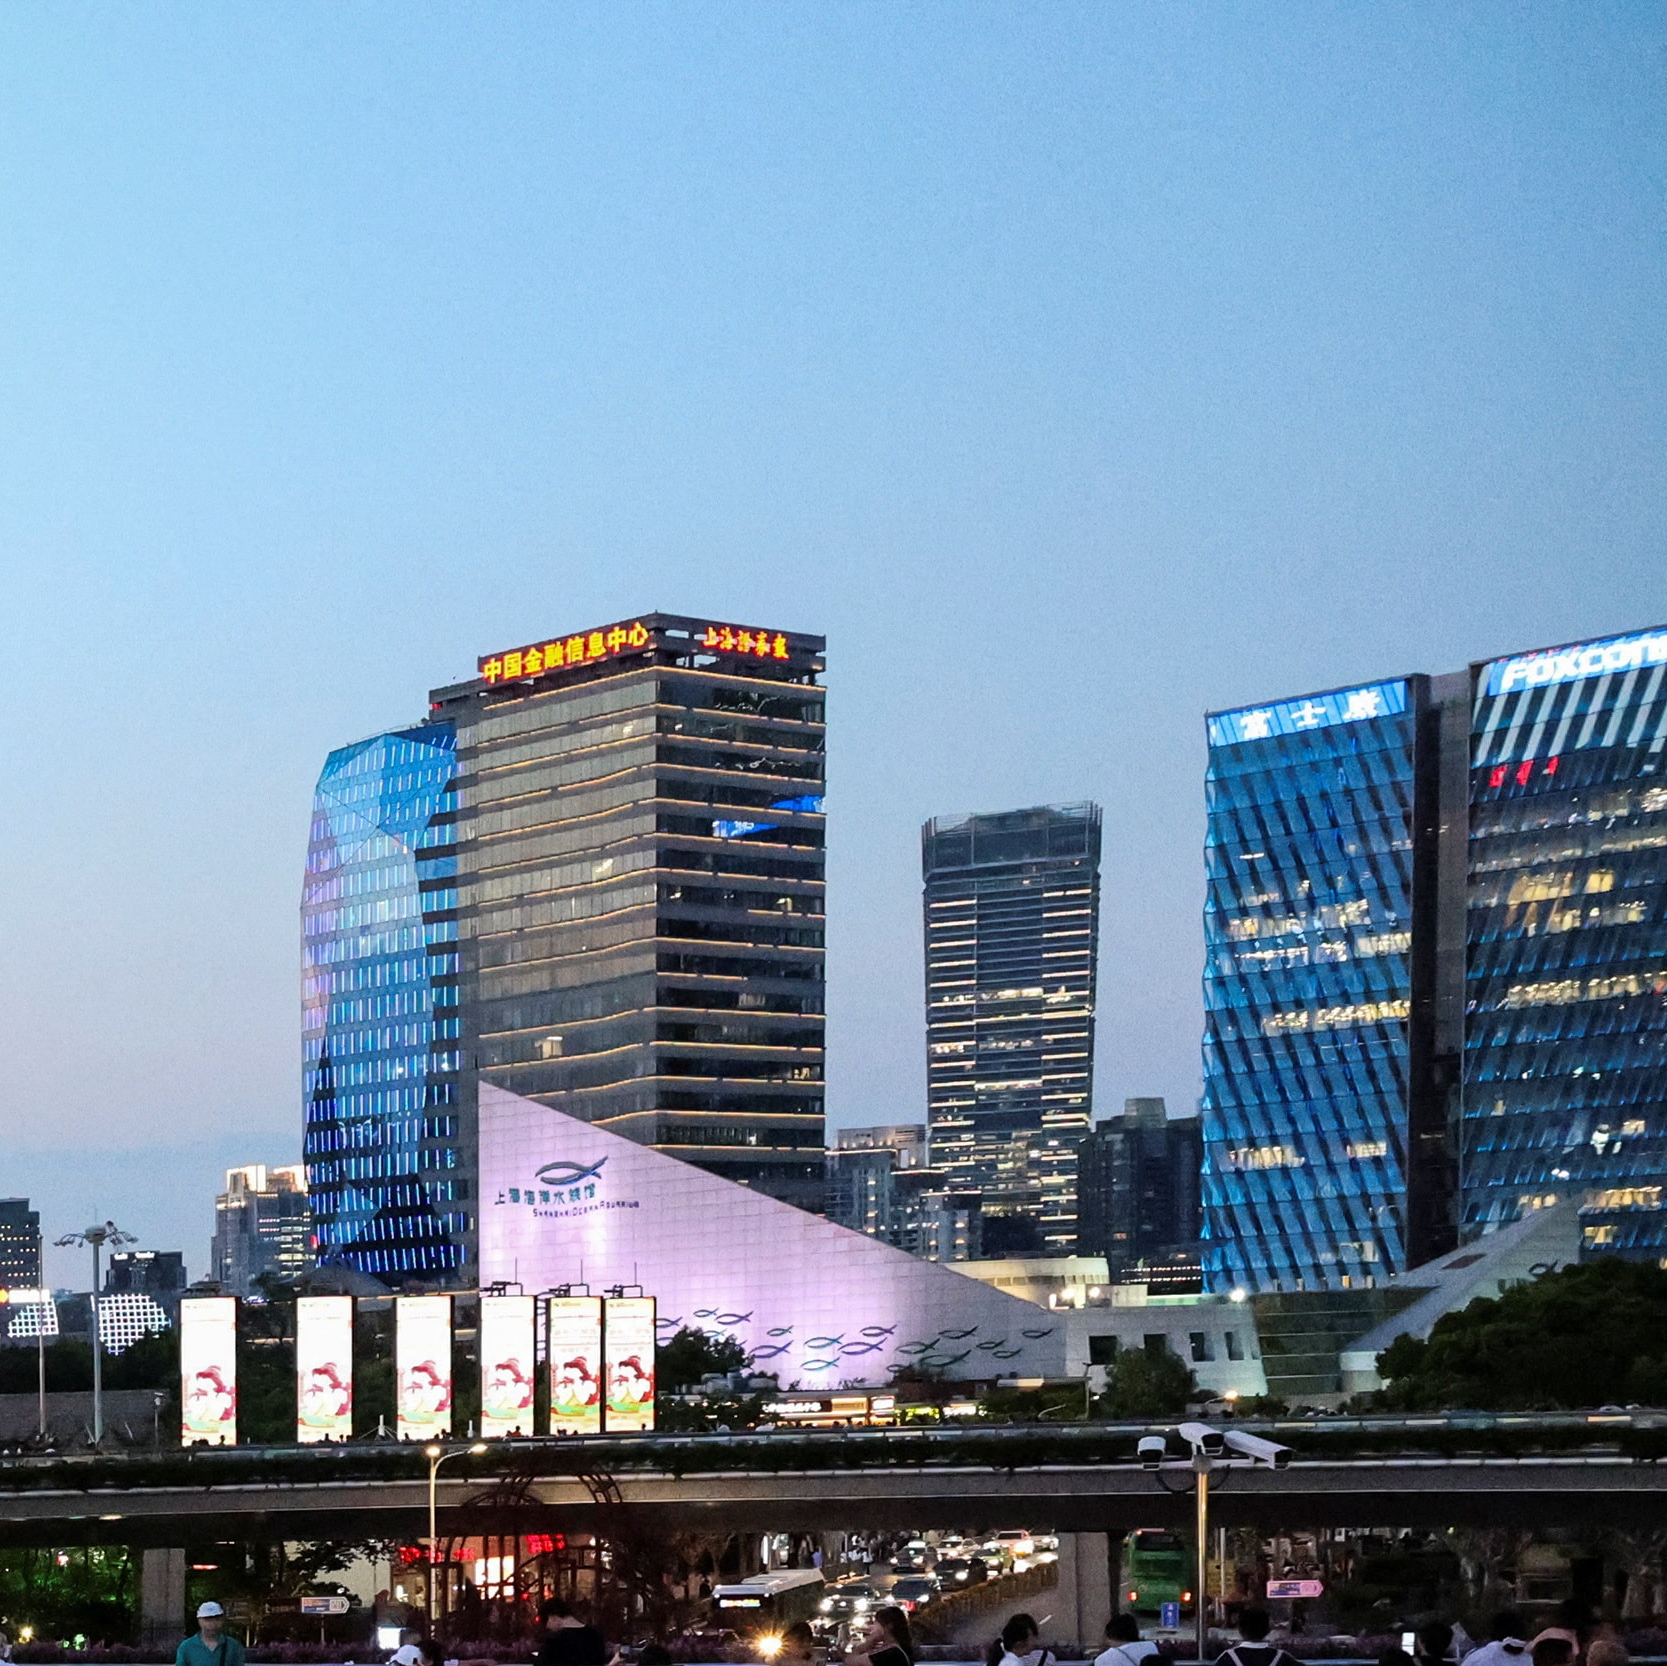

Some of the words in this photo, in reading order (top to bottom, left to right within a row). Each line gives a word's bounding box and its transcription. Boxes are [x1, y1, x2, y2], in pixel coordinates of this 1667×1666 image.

[482, 622, 649, 684] 中国金融信息中心
[1500, 634, 1667, 692] FOXCON
